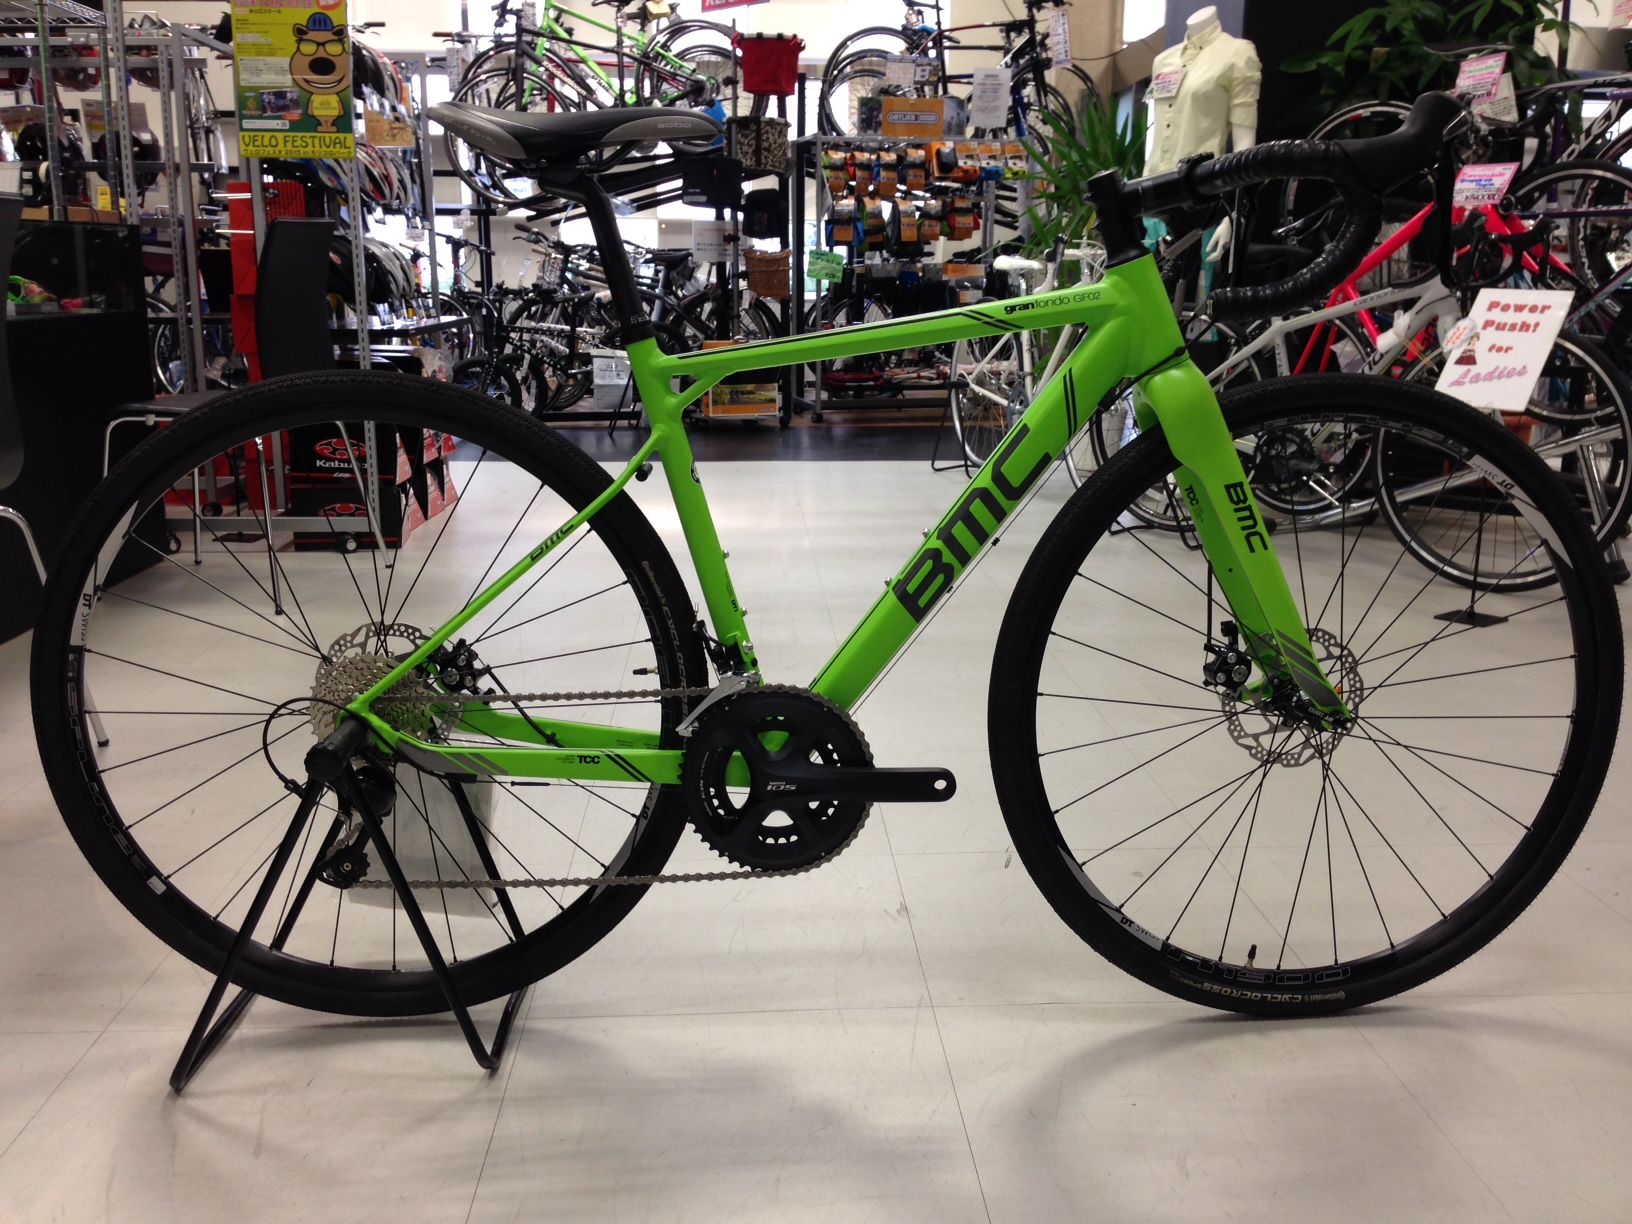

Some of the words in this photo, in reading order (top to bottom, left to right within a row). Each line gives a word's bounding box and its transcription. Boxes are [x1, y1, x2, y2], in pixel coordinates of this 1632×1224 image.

[242, 134, 279, 148] VELO
[283, 135, 351, 149] FESTIVAL
[1004, 295, 1071, 315] granfondo
[1073, 291, 1101, 303] GF02
[1486, 301, 1552, 314] Power
[1481, 319, 1541, 333] Push!
[1488, 343, 1514, 354] for
[1447, 364, 1529, 388] Ladies
[1497, 478, 1516, 491] DT
[1184, 484, 1199, 507] TCC
[892, 422, 1052, 624] BMC
[1223, 481, 1269, 554] BMC
[82, 592, 92, 610] DT
[577, 755, 601, 765] TCC
[641, 802, 651, 820] DT
[1120, 915, 1135, 929] DT
[1202, 982, 1303, 1003] CYCLOCROSS
[1310, 990, 1346, 1003] Continental
